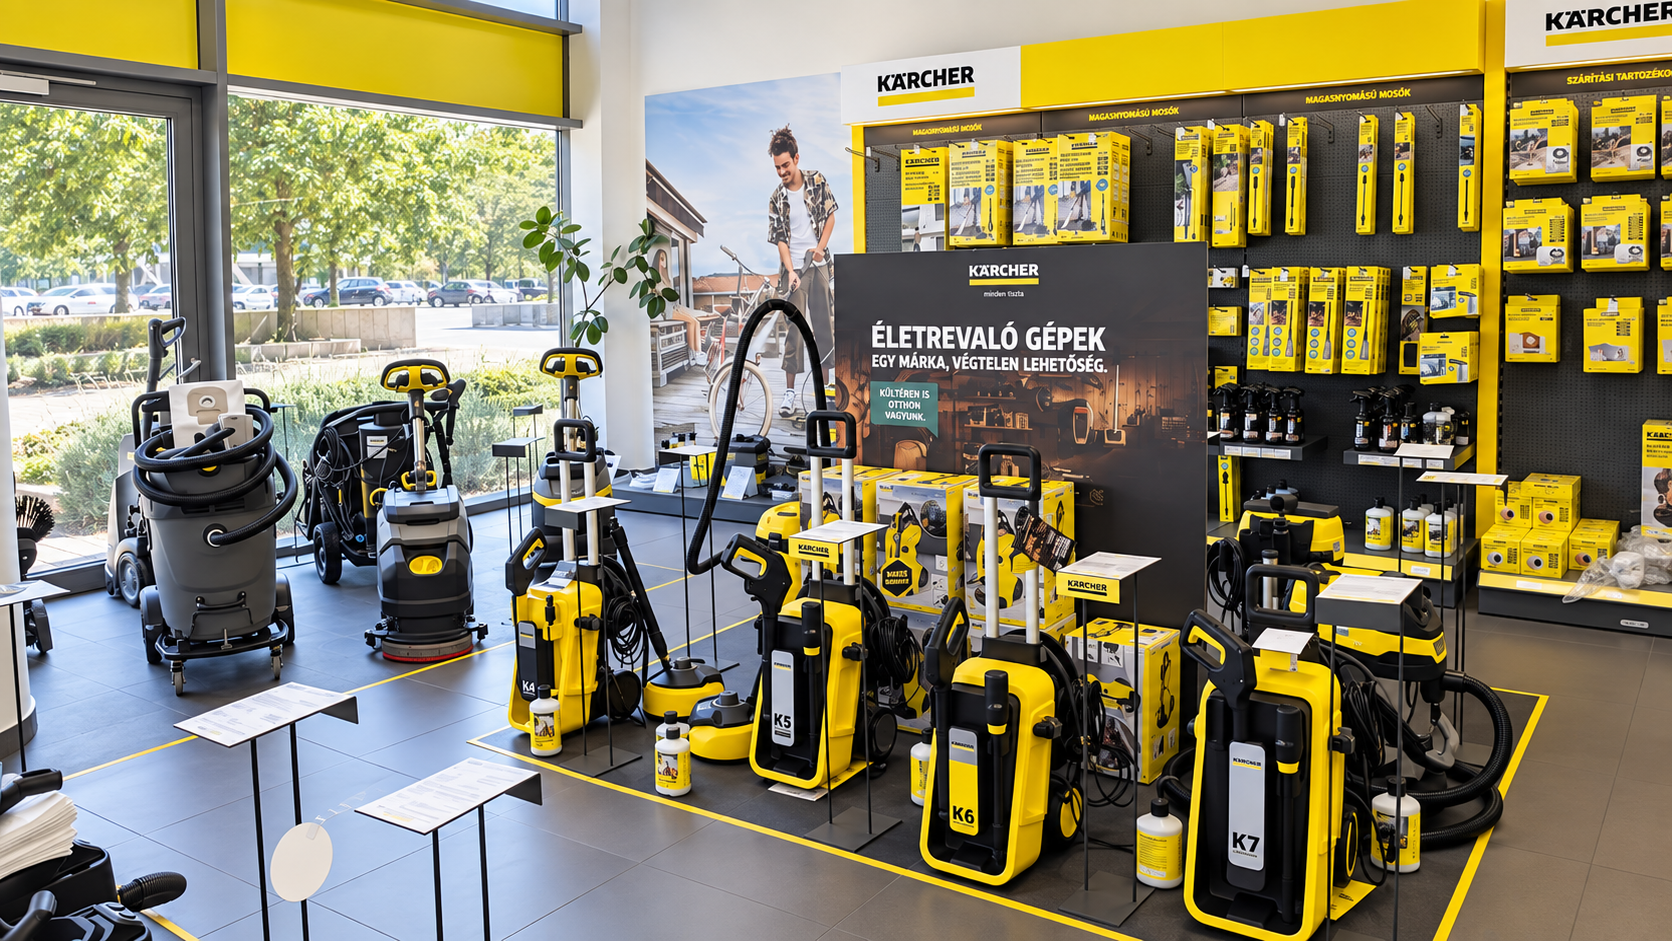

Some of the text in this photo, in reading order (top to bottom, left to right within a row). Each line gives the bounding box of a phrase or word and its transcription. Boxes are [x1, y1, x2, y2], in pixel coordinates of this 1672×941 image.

[1546, 1, 1672, 31] KÄRCHER
[878, 66, 975, 92] KÄRCHER
[1567, 68, 1672, 85] SZÁRÍTÁSI TARTOZÉKO
[969, 264, 1039, 277] KÄRCHER
[871, 320, 1106, 351] ÉLETREVALÓ GÉPEK
[872, 353, 1108, 373] EGY MÁRKA, VÉGTELEN LEHETŐSÉG.
[922, 390, 930, 399] IS
[888, 400, 921, 409] OTTHON
[885, 411, 926, 421] VAGYUNK.
[774, 713, 791, 729] K5
[952, 805, 975, 824] K6
[1232, 832, 1260, 853] K7
